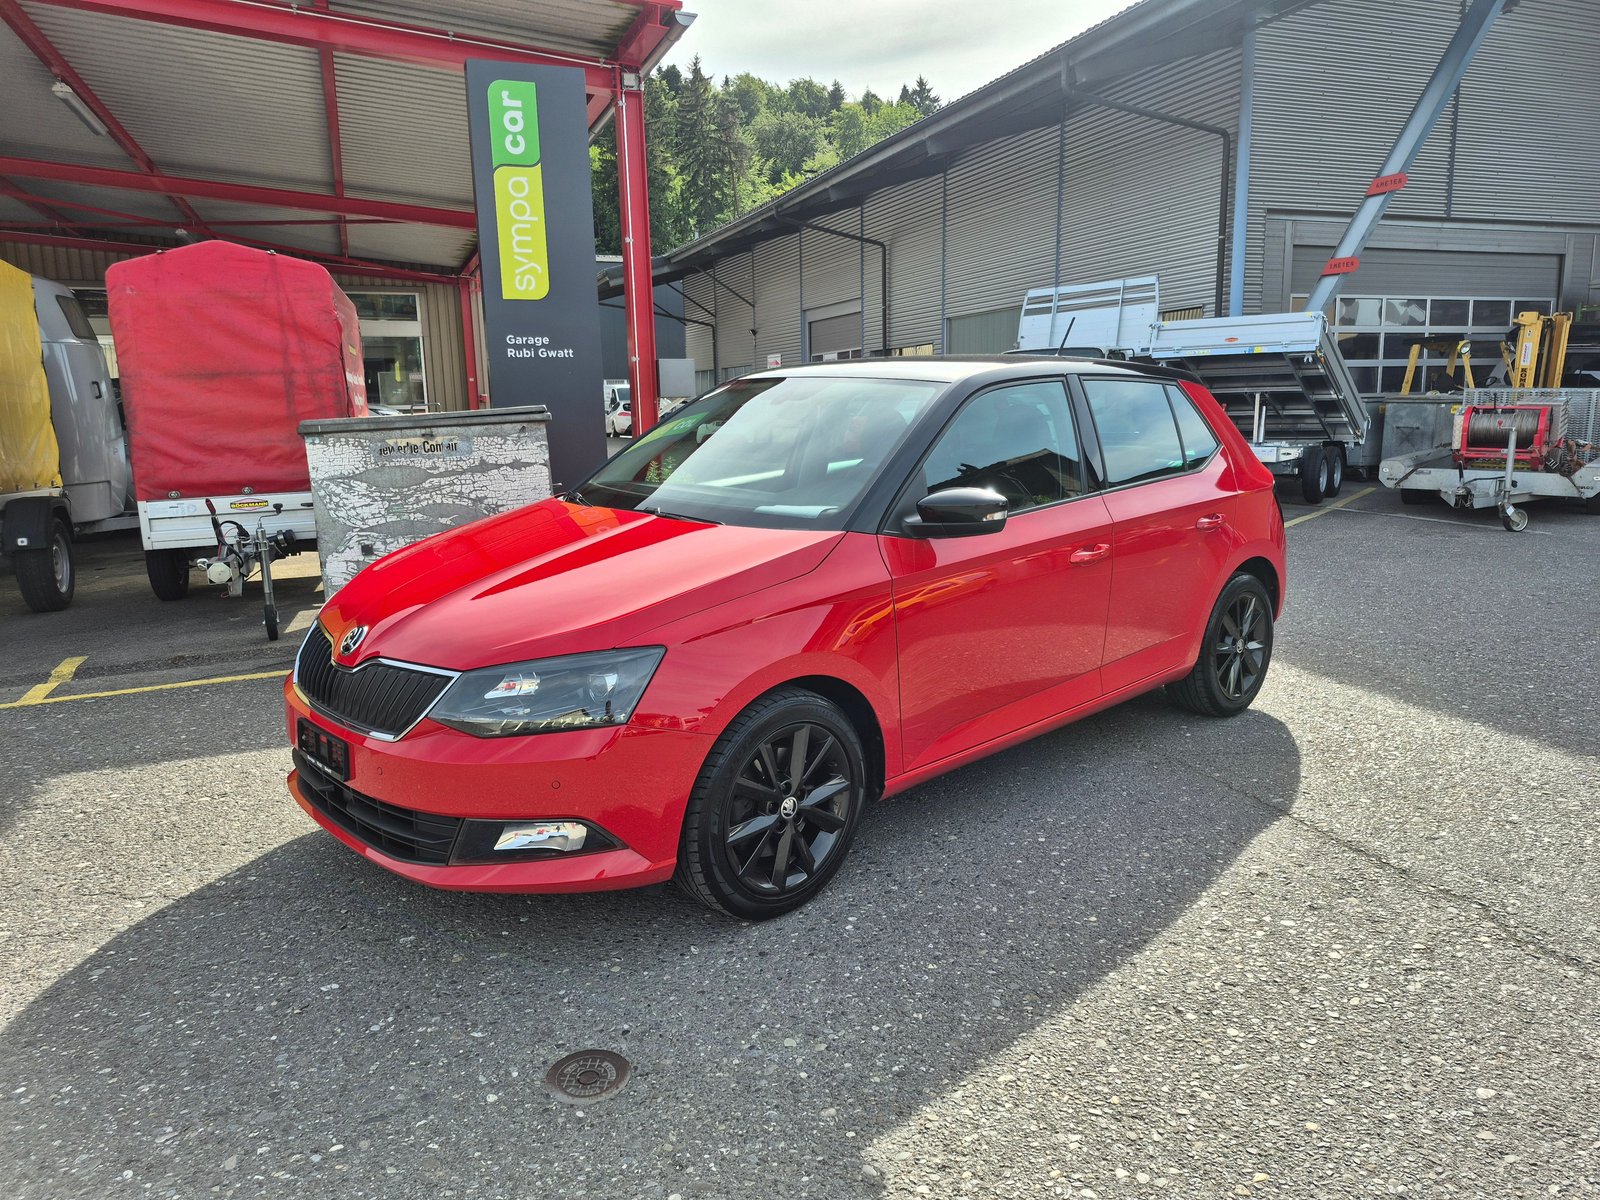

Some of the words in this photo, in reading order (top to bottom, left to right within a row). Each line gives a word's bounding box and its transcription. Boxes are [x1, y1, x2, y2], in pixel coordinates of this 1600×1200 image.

[501, 90, 526, 155] car
[508, 176, 542, 291] sympa
[506, 334, 550, 346] Garage
[507, 348, 535, 358] Rubi
[538, 348, 574, 358] Gwatt
